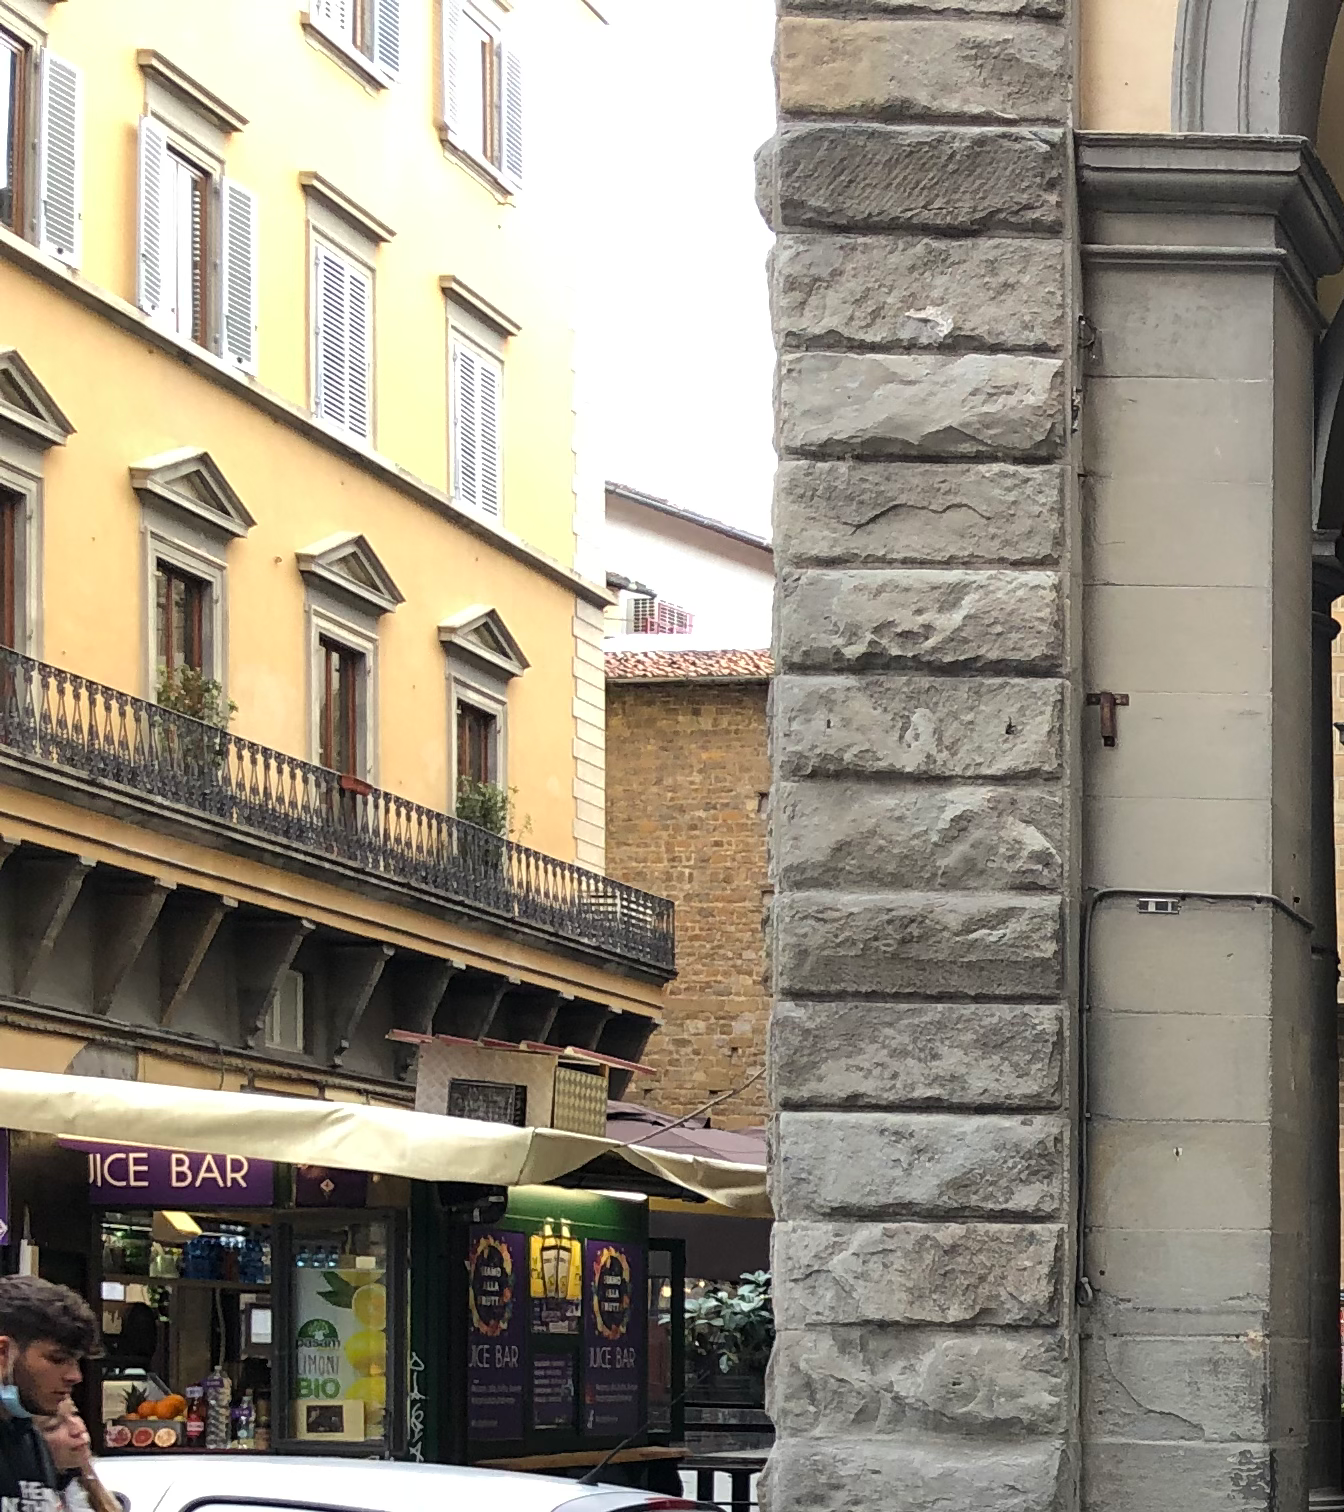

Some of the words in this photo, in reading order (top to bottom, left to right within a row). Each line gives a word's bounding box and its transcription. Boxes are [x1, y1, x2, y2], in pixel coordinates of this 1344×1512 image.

[171, 1153, 249, 1188] BAR
[495, 1344, 519, 1368] BAR
[615, 1347, 637, 1369] BAR
[296, 1377, 341, 1399] BIO
